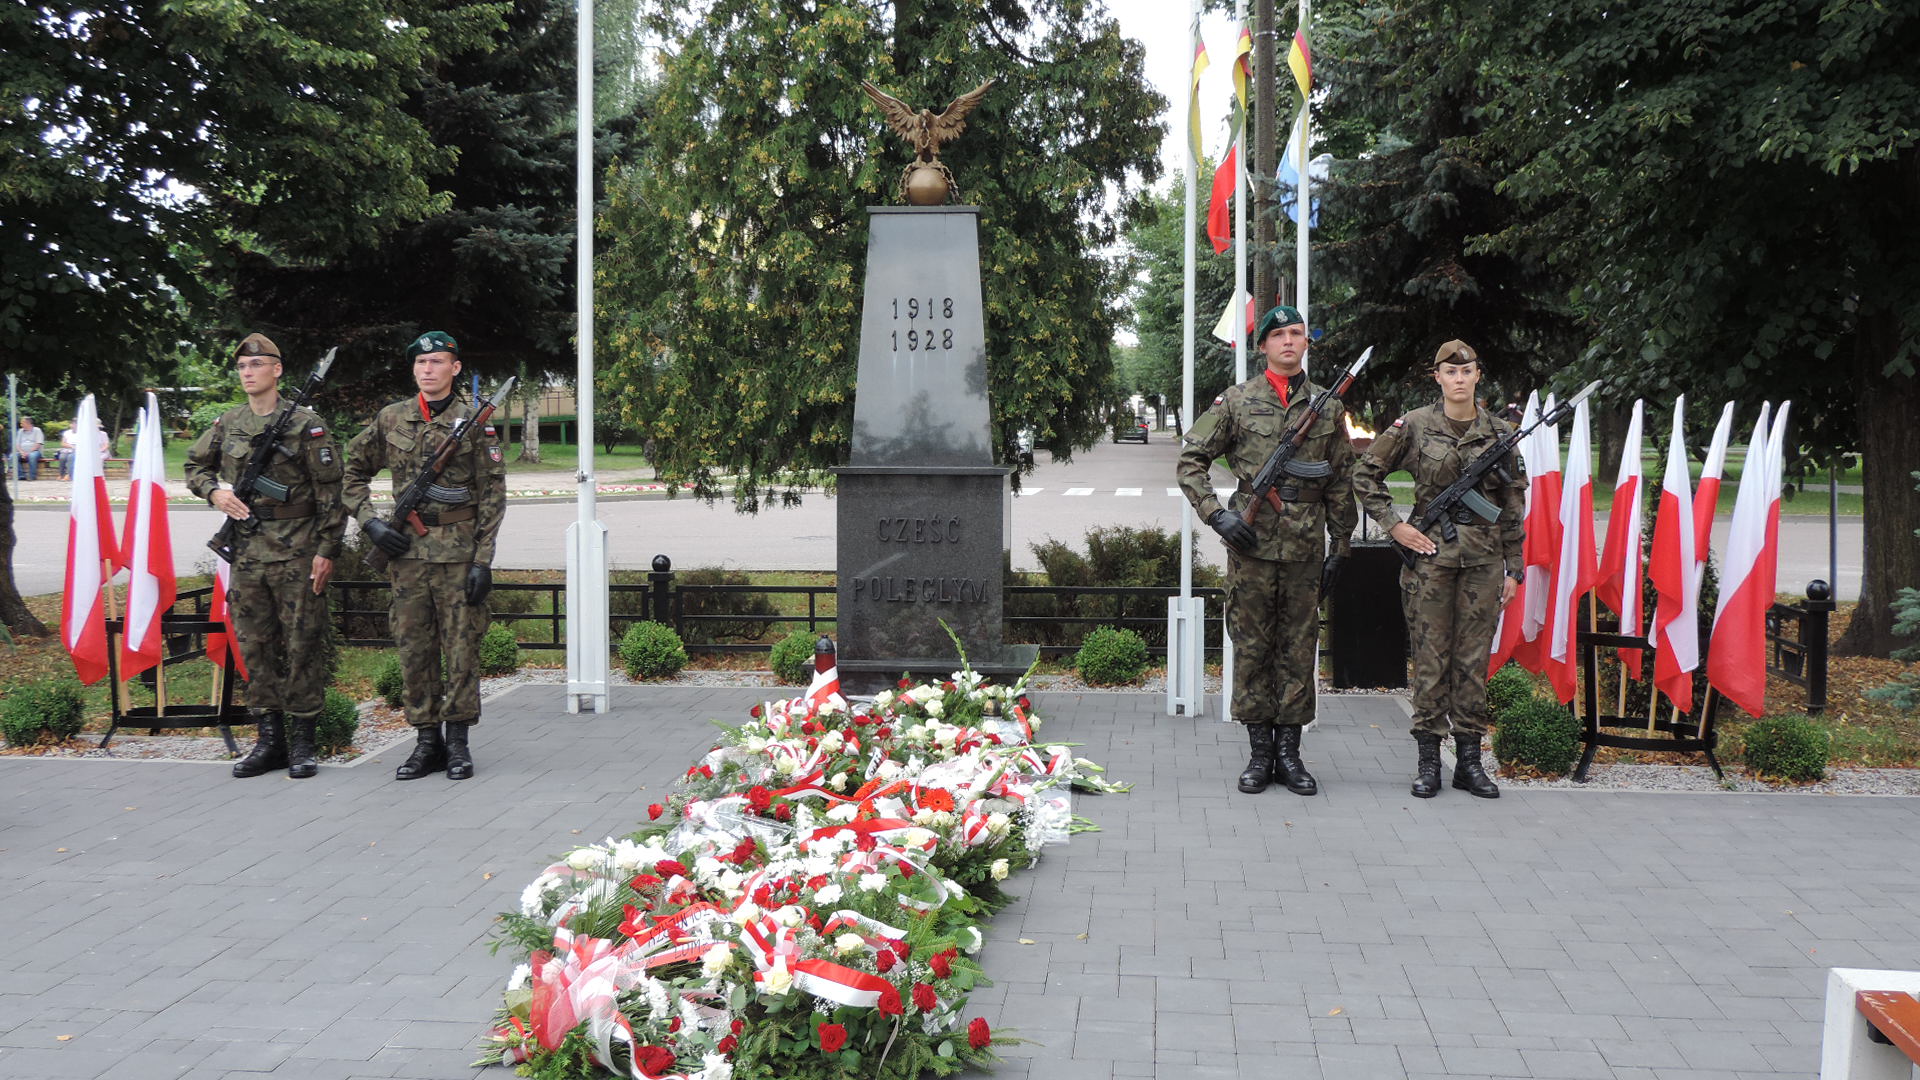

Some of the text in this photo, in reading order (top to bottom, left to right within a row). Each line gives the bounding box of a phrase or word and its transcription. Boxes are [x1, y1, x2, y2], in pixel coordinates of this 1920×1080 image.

[891, 297, 954, 320] 1918
[891, 328, 954, 352] 1928
[877, 514, 961, 544] CZEŚĆ
